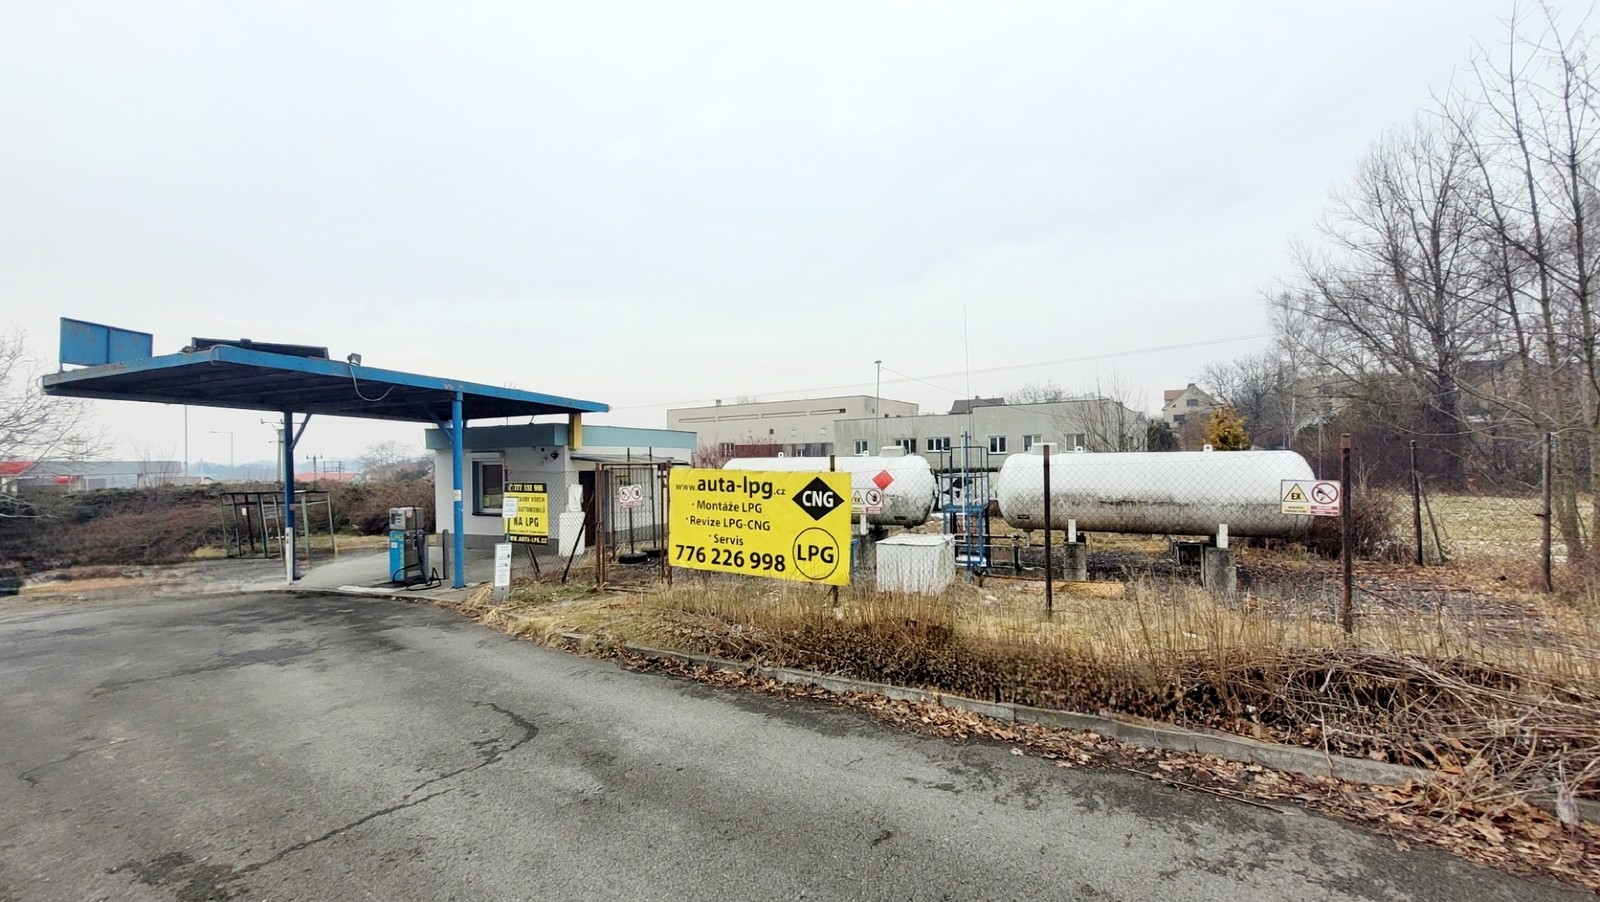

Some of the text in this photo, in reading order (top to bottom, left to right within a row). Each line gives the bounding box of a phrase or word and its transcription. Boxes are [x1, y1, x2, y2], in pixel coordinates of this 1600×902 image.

[675, 475, 786, 499] www.auta-lpg.cz
[696, 500, 762, 513] Montáže LPG
[802, 490, 834, 508] CNG
[514, 517, 539, 527] NA LPG
[690, 515, 771, 531] Revize LPG-CNG
[713, 533, 744, 546] Servis
[675, 544, 786, 572] 776 226 998
[797, 544, 834, 564] LPG
